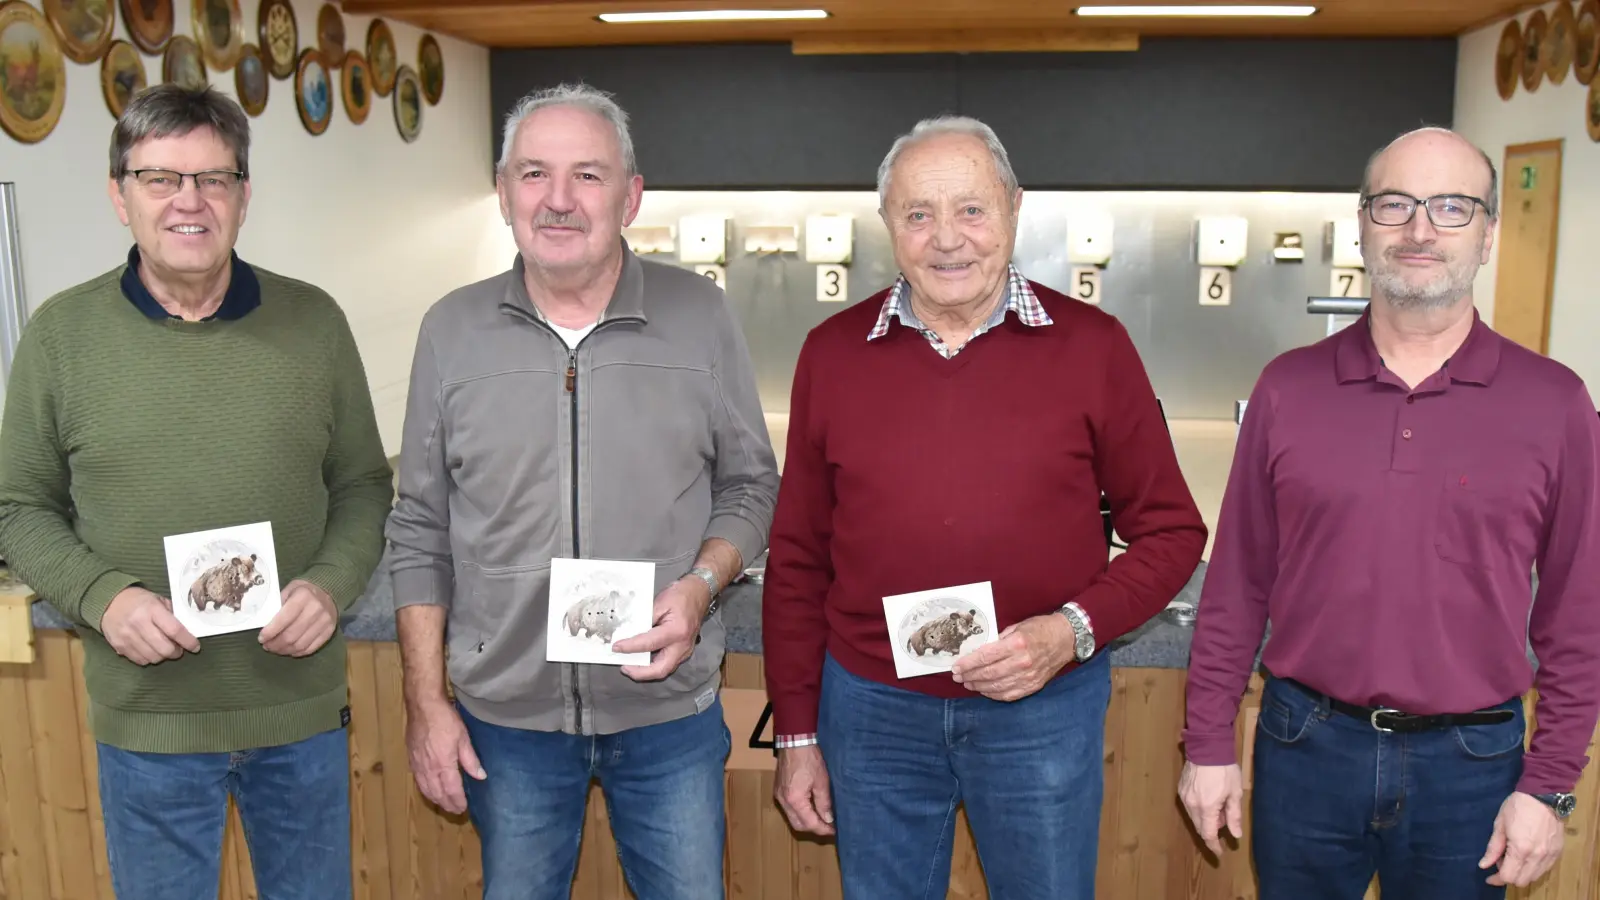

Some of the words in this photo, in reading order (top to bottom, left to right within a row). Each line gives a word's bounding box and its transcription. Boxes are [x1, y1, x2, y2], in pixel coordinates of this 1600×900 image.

[825, 270, 840, 297] 3
[1078, 272, 1095, 298] 5
[1207, 273, 1224, 299] 6
[1339, 275, 1354, 297] 7
[749, 701, 777, 757] 4
